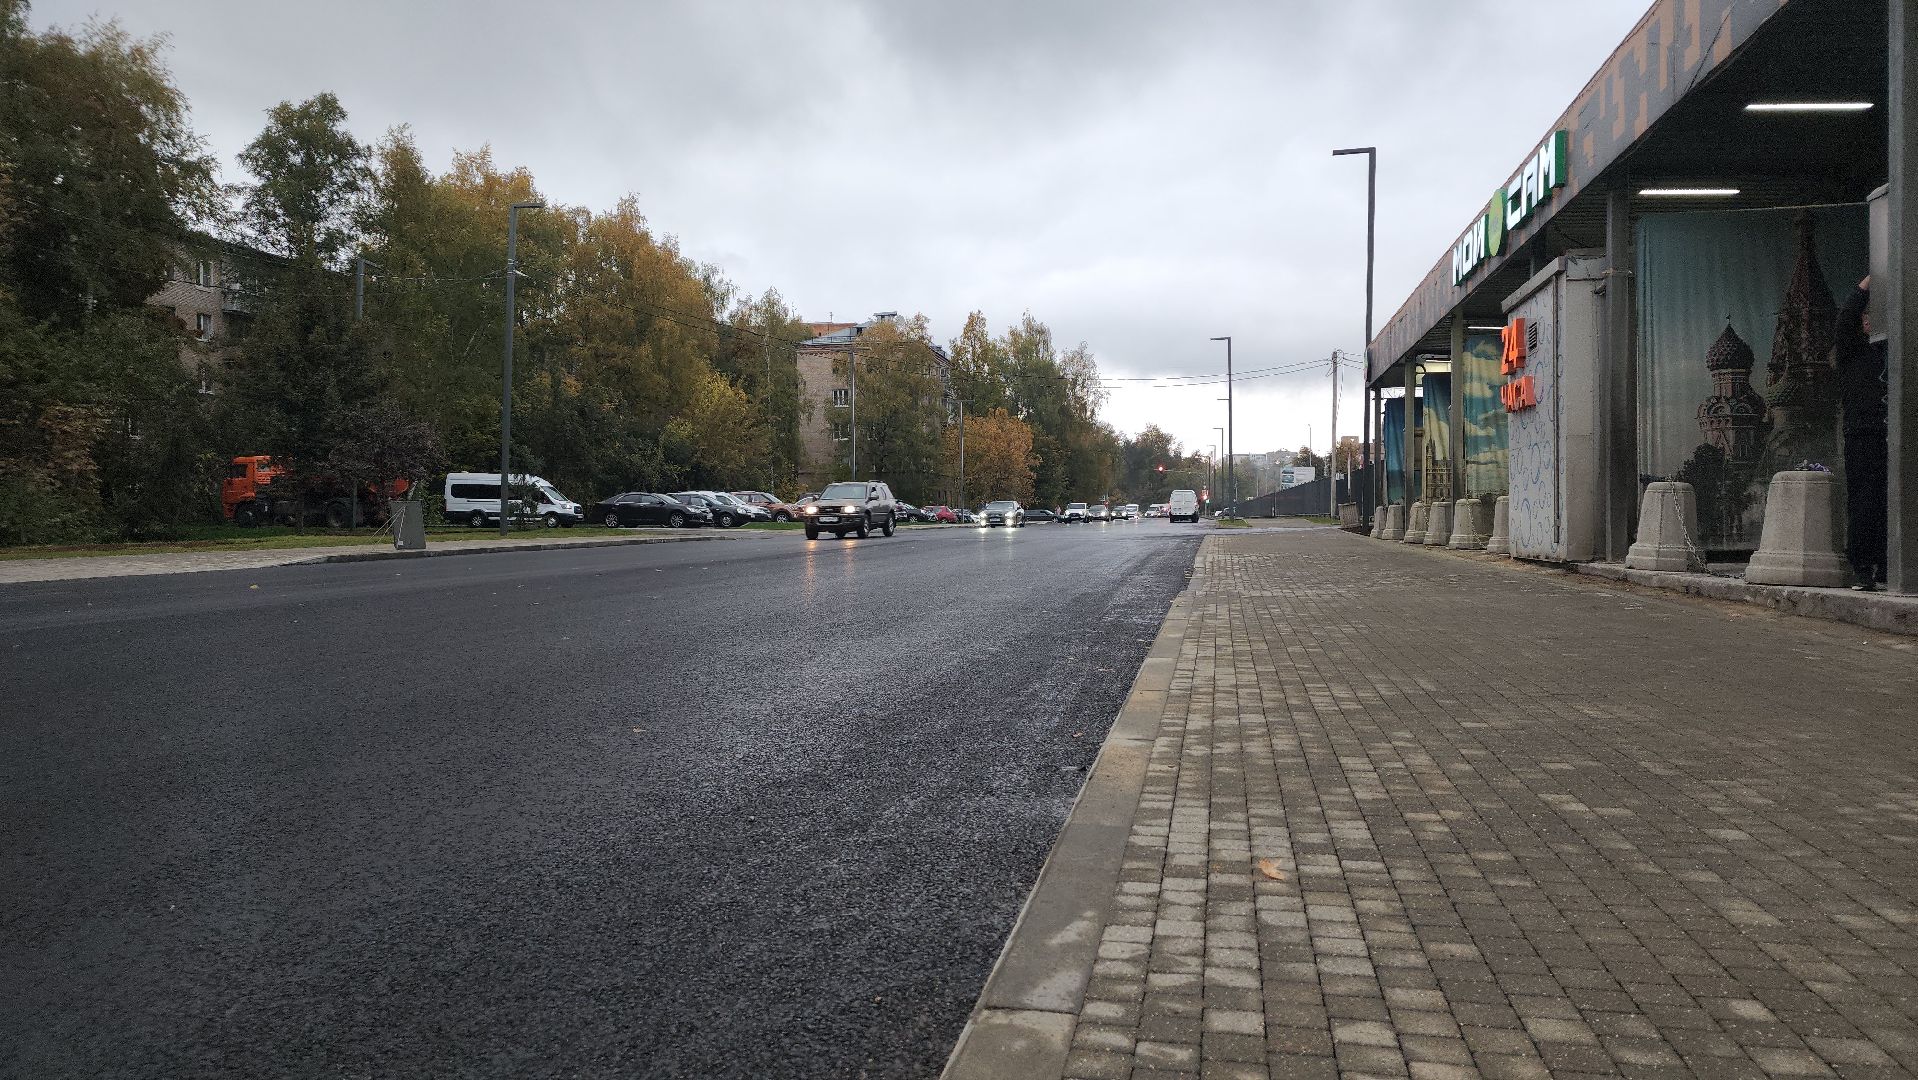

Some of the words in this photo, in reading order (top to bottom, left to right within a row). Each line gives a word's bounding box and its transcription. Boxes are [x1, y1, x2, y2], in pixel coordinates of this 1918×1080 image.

[1506, 131, 1557, 231] САМ
[1501, 318, 1522, 374] 24
[1501, 376, 1530, 411] ЧАСА
